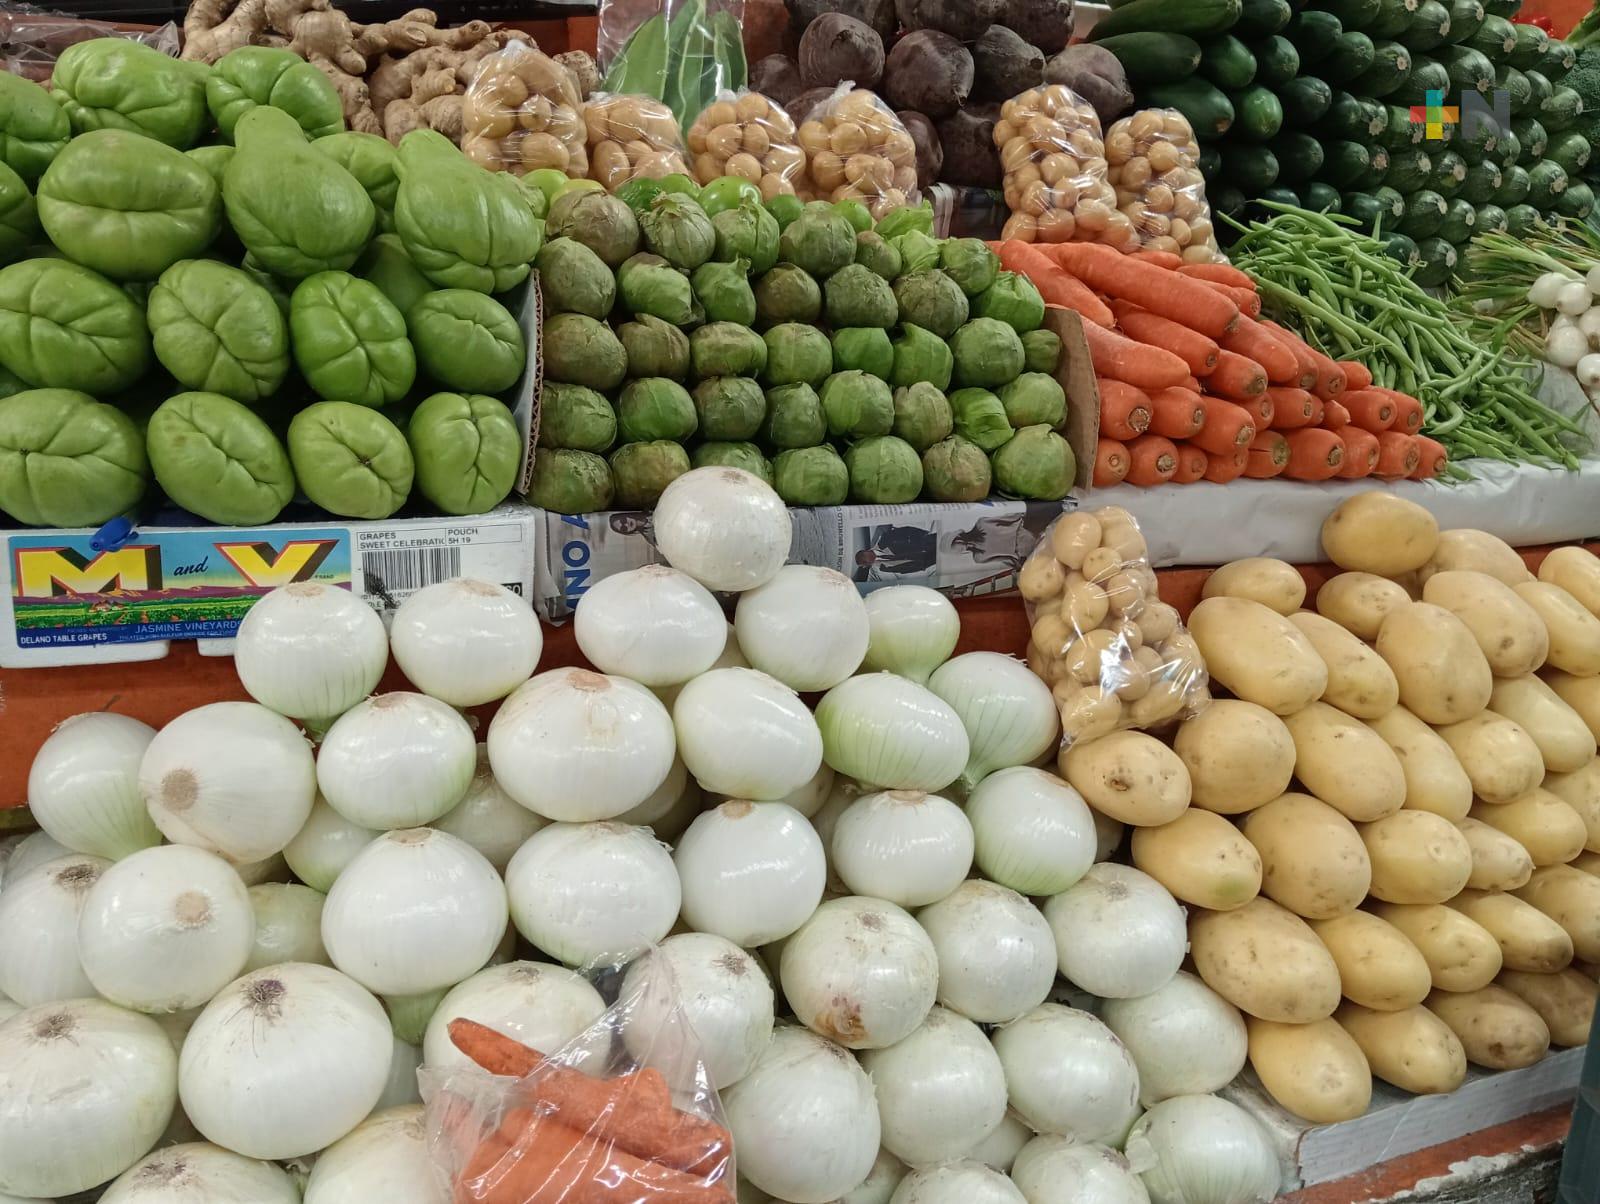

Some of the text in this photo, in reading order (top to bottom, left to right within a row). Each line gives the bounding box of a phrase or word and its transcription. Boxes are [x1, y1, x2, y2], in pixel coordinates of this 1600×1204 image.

[448, 527, 479, 536] POUCH
[359, 532, 397, 541] GRAPES
[462, 536, 471, 544] 19
[360, 541, 390, 550] SWEET
[14, 540, 339, 598] M and V
[135, 623, 181, 633] JASMINE
[52, 634, 76, 643] TABLE
[77, 633, 107, 642] GRAPES
